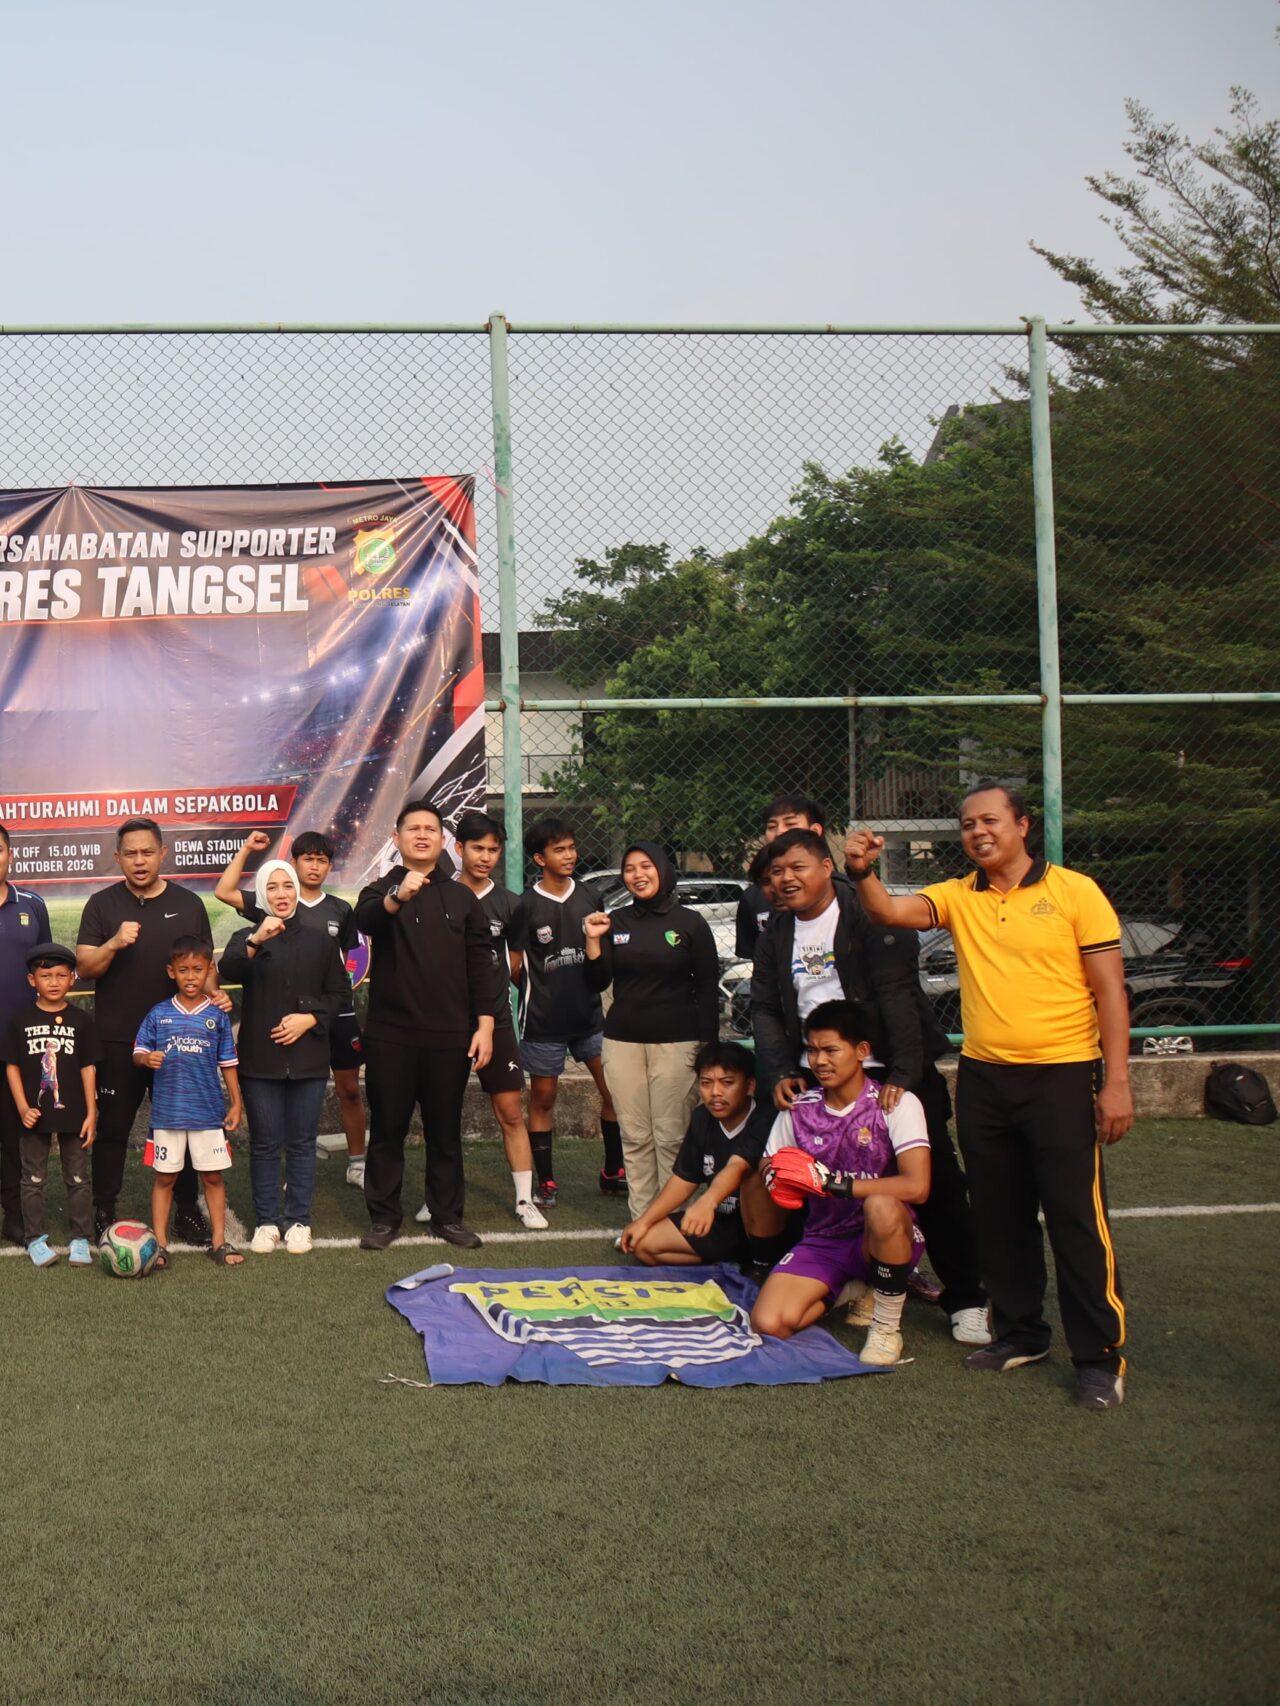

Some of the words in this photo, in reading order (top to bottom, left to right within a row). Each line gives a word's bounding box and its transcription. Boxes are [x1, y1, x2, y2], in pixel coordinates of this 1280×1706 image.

[180, 527, 336, 558] SUPPORTER
[97, 564, 309, 617] TANGSEL
[348, 587, 411, 603] POLRES
[106, 798, 168, 816] DALAM
[175, 794, 279, 813] SEPAKBOLA
[22, 846, 40, 858] OFF
[48, 845, 77, 857] 15.00
[80, 844, 101, 856] WIB
[175, 840, 203, 852] DEWA
[206, 839, 247, 852] STADIU
[15, 860, 64, 873] OKTOBER
[67, 859, 94, 872] 2026
[175, 853, 237, 866] CICALENGK
[24, 1025, 51, 1037] THE
[52, 1025, 75, 1037] JAK
[27, 1037, 75, 1055] KID'S
[176, 1044, 203, 1053] Youth
[155, 1145, 168, 1161] 93
